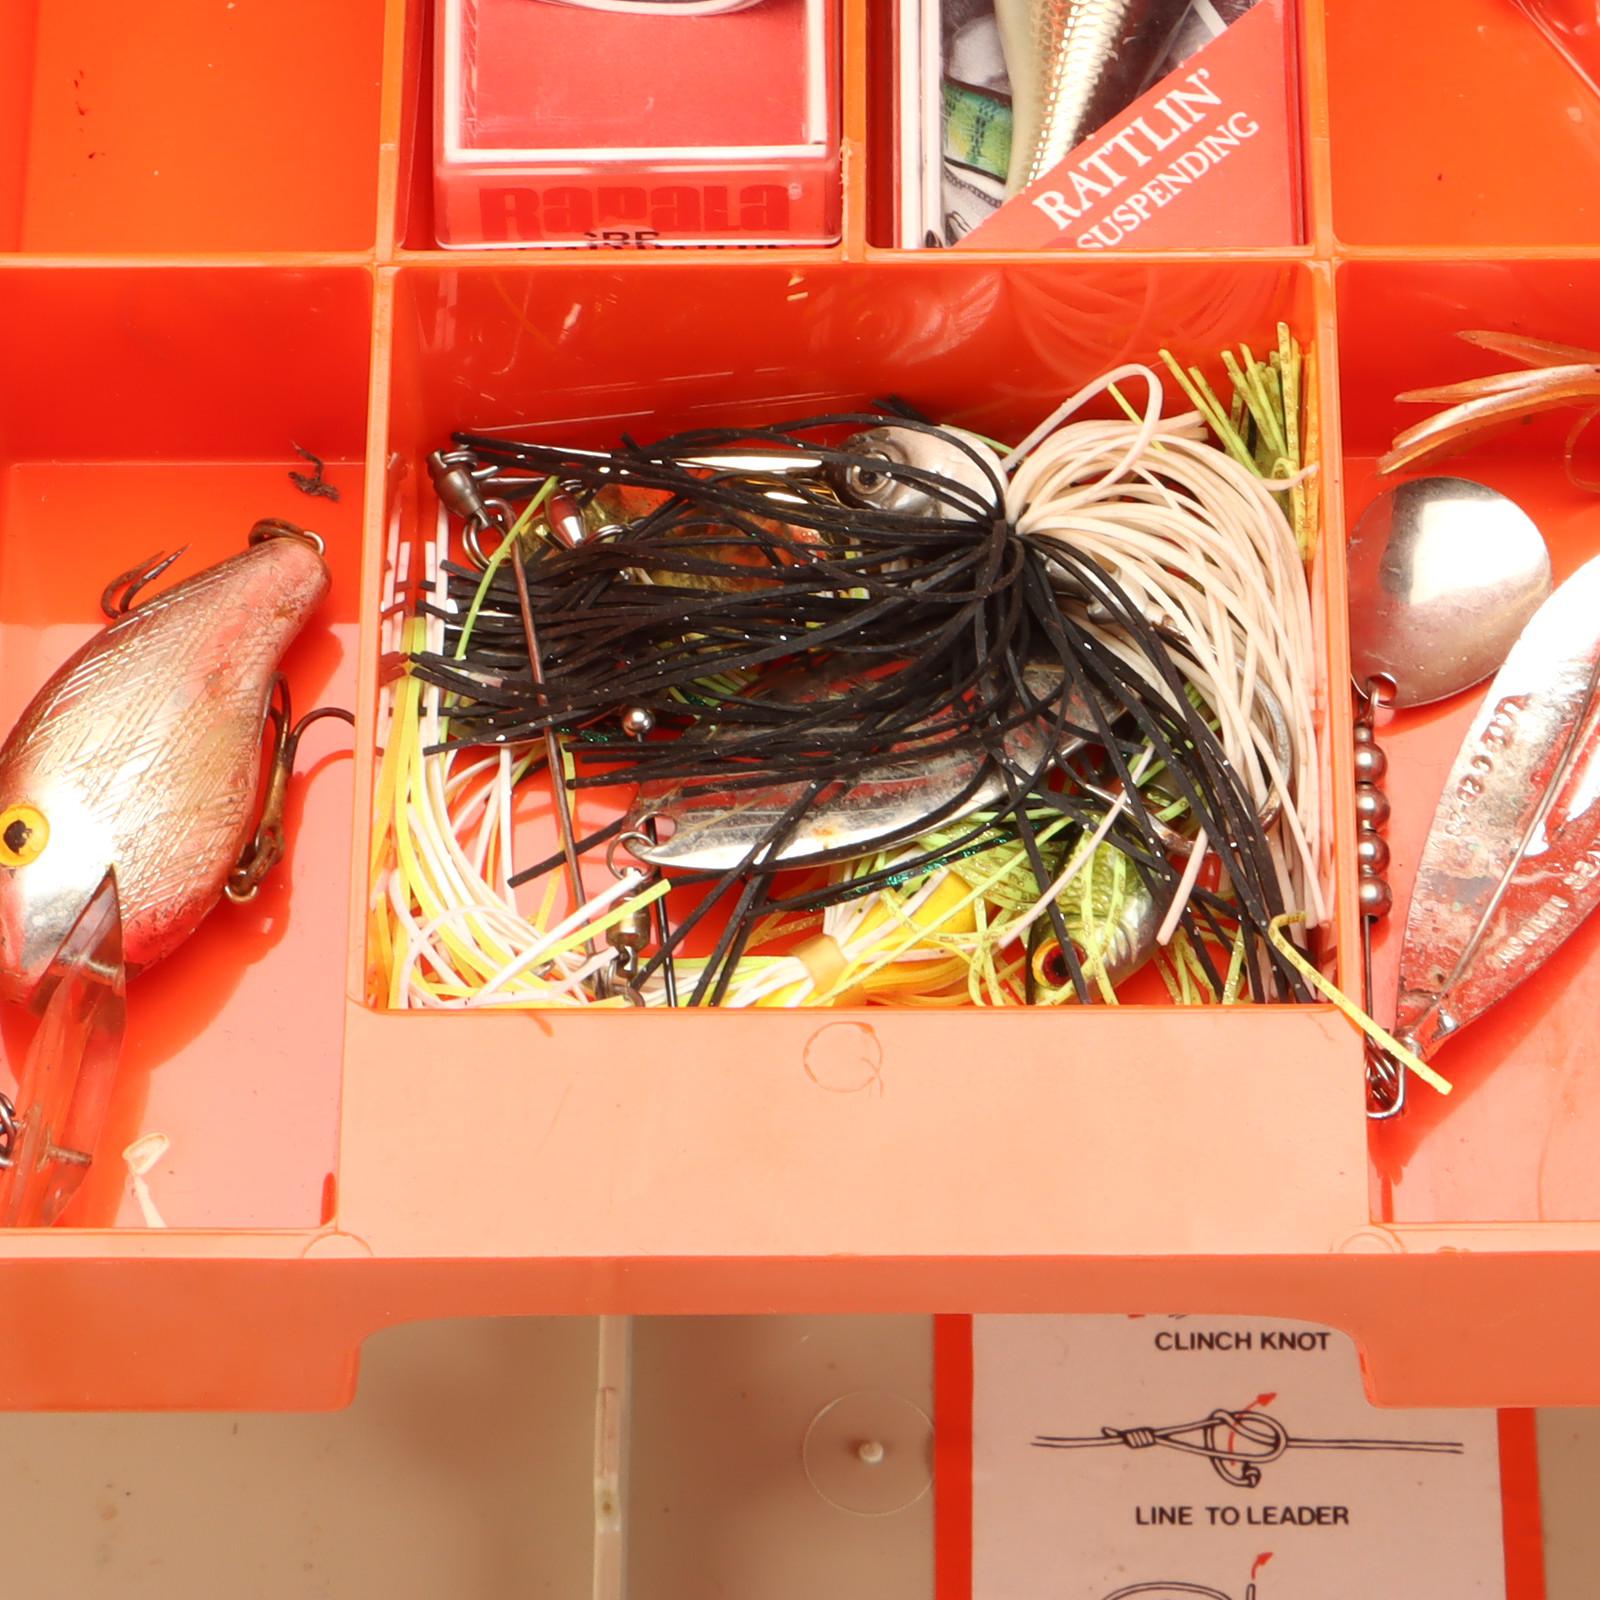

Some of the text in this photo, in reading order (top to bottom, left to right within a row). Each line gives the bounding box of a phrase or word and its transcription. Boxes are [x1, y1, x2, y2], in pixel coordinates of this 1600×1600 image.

[1032, 68, 1223, 231] RATTLIN'
[1075, 111, 1261, 249] SUSPENDING
[1154, 1331, 1331, 1352] CLINCH KNOT
[1134, 1504, 1349, 1526] LINE TO LEADER
